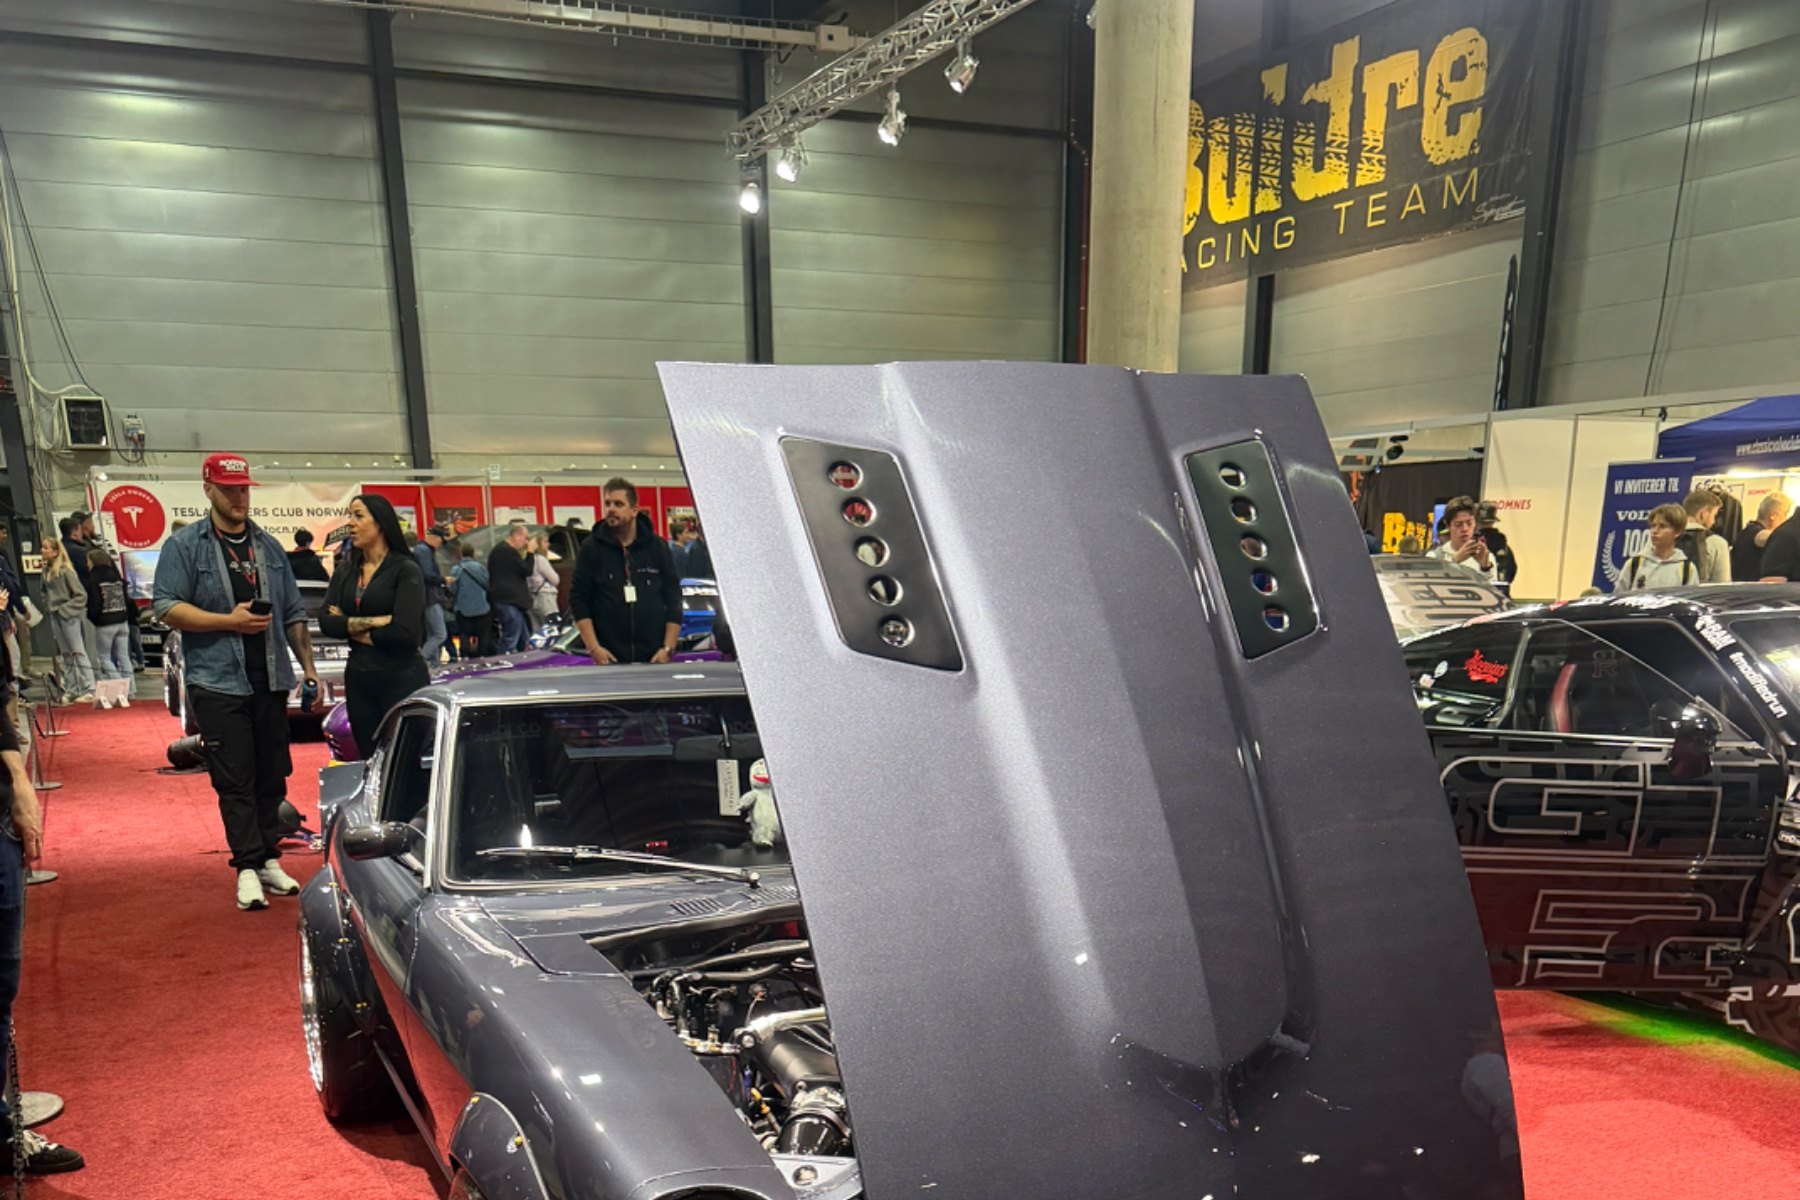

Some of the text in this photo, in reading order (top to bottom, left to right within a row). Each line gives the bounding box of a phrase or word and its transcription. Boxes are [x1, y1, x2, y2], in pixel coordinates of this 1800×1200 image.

[1180, 215, 1295, 273] CING
[1333, 167, 1479, 235] TEAM
[172, 507, 352, 517] TESLA ERS CLUB NORWA
[1616, 510, 1650, 521] VOL
